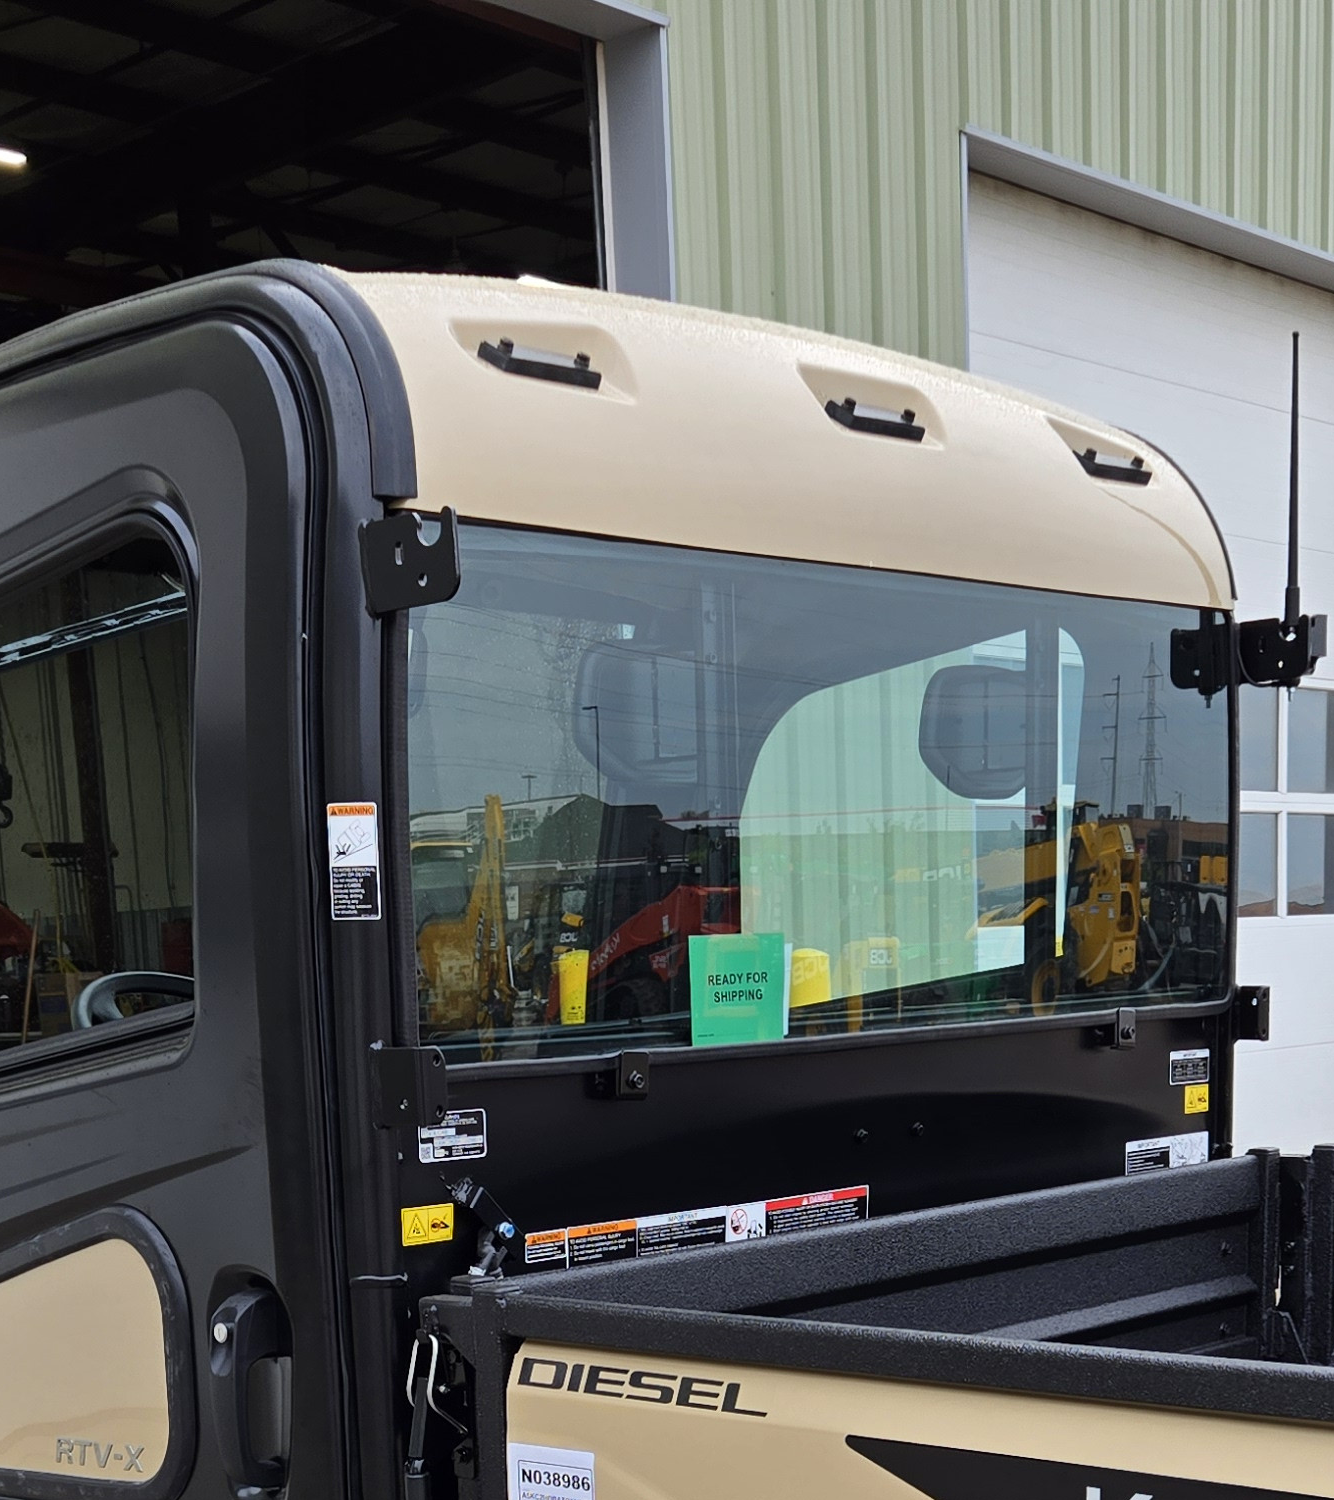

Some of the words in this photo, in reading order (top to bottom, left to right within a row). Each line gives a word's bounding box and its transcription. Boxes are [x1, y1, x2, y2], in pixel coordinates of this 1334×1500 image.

[337, 806, 374, 816] WARNING
[708, 973, 743, 986] READY
[746, 972, 768, 983] FOR
[714, 989, 763, 1003] SHIPPING
[517, 1357, 768, 1417] DIESEL
[56, 1438, 145, 1473] RTV-X
[522, 1468, 590, 1491] N038986
